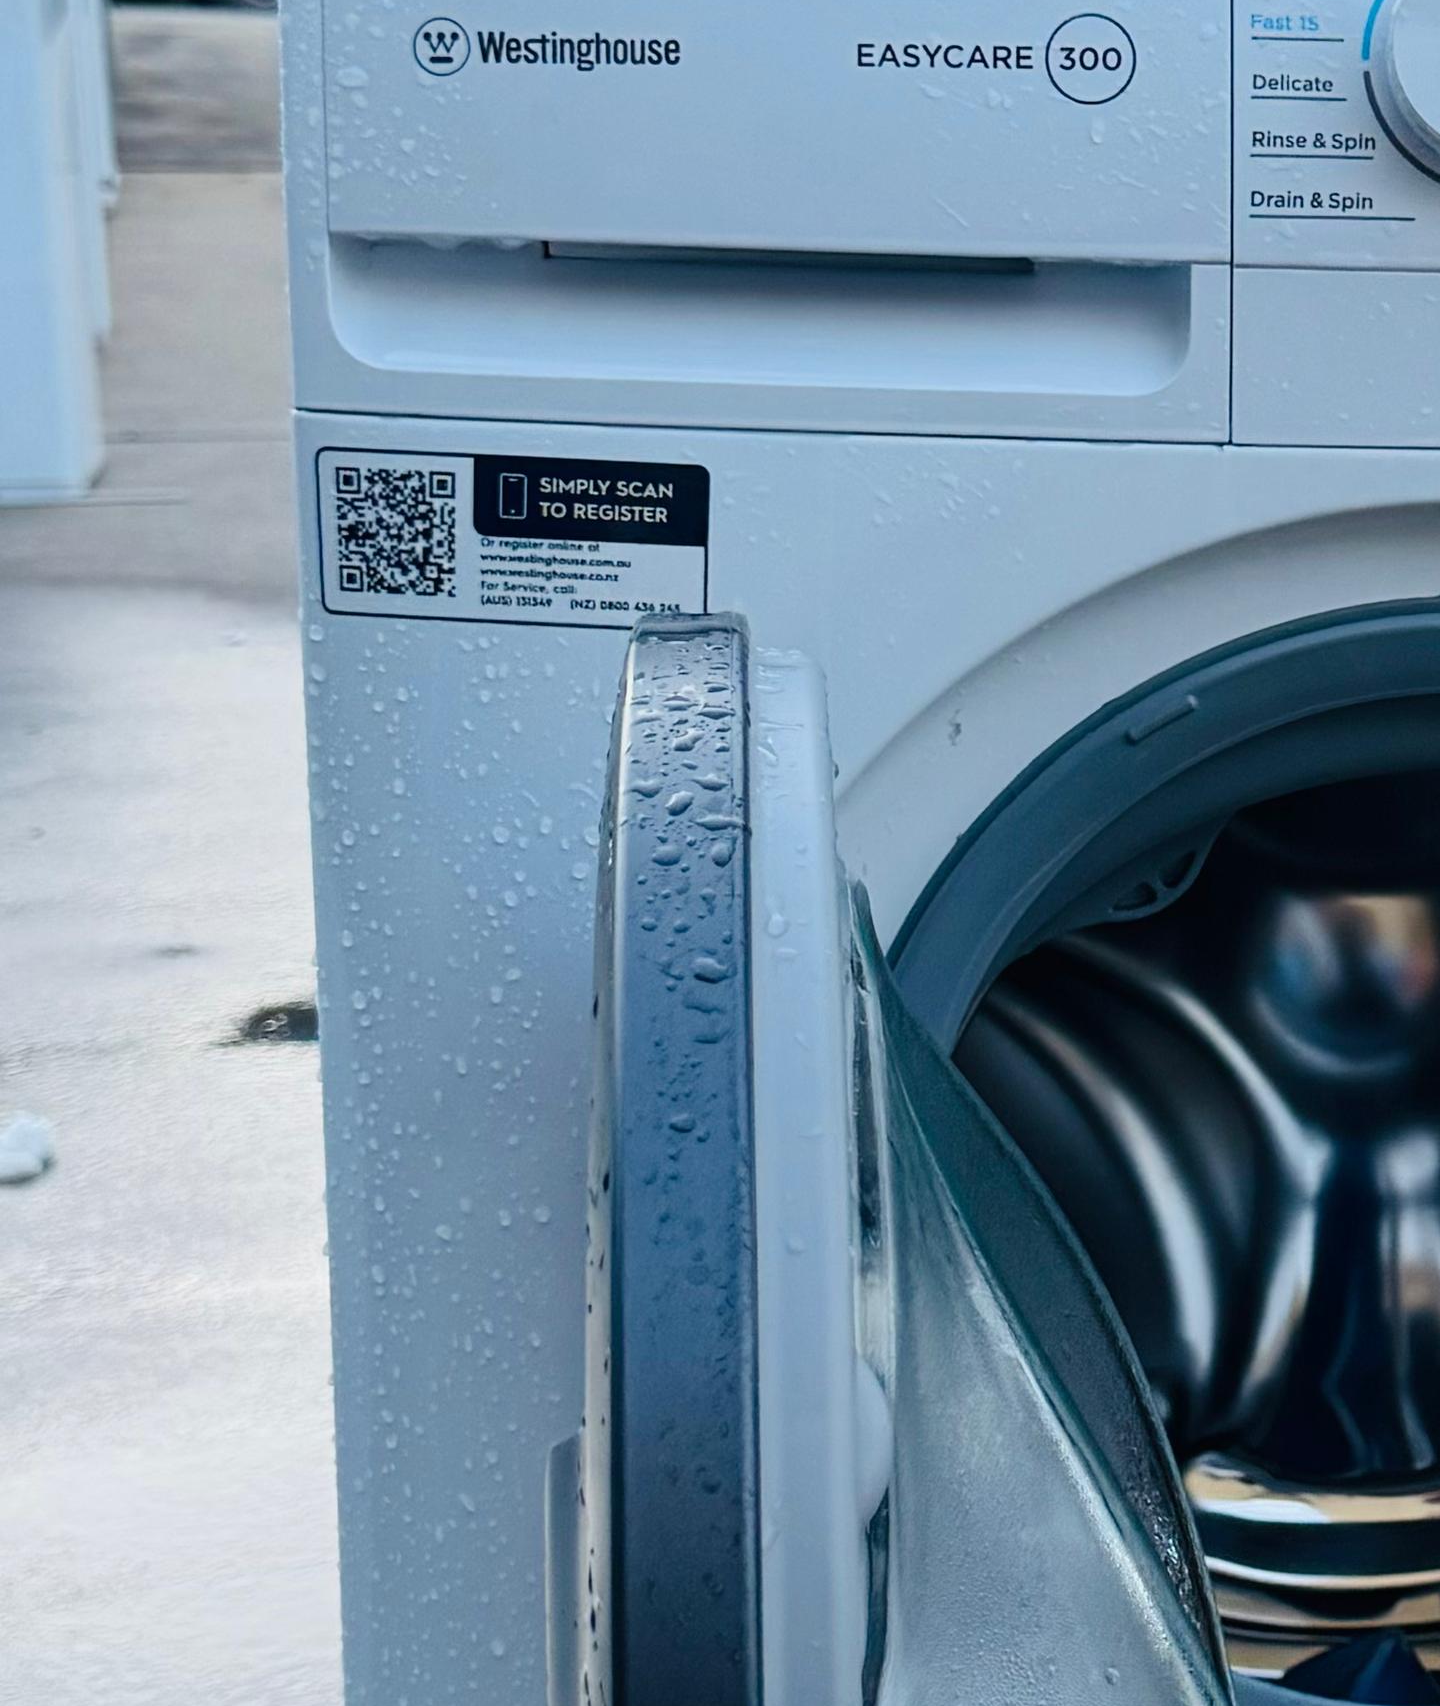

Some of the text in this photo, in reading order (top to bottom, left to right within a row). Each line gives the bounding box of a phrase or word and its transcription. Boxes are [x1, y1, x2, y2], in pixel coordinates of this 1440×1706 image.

[1250, 13, 1320, 32] Fast 15
[477, 30, 681, 72] Westinghouse
[856, 43, 1123, 71] EASYCARE 300
[1252, 73, 1334, 93] Delicate
[1251, 130, 1377, 153] Rinse & Spin
[1250, 190, 1374, 212] Drain & Spin
[539, 477, 674, 499] SIMPLY SCAN
[538, 501, 668, 524] TO REGISTER
[499, 537, 544, 552] register
[547, 541, 584, 553] online
[480, 580, 500, 592] For
[570, 599, 597, 611] (NZ)
